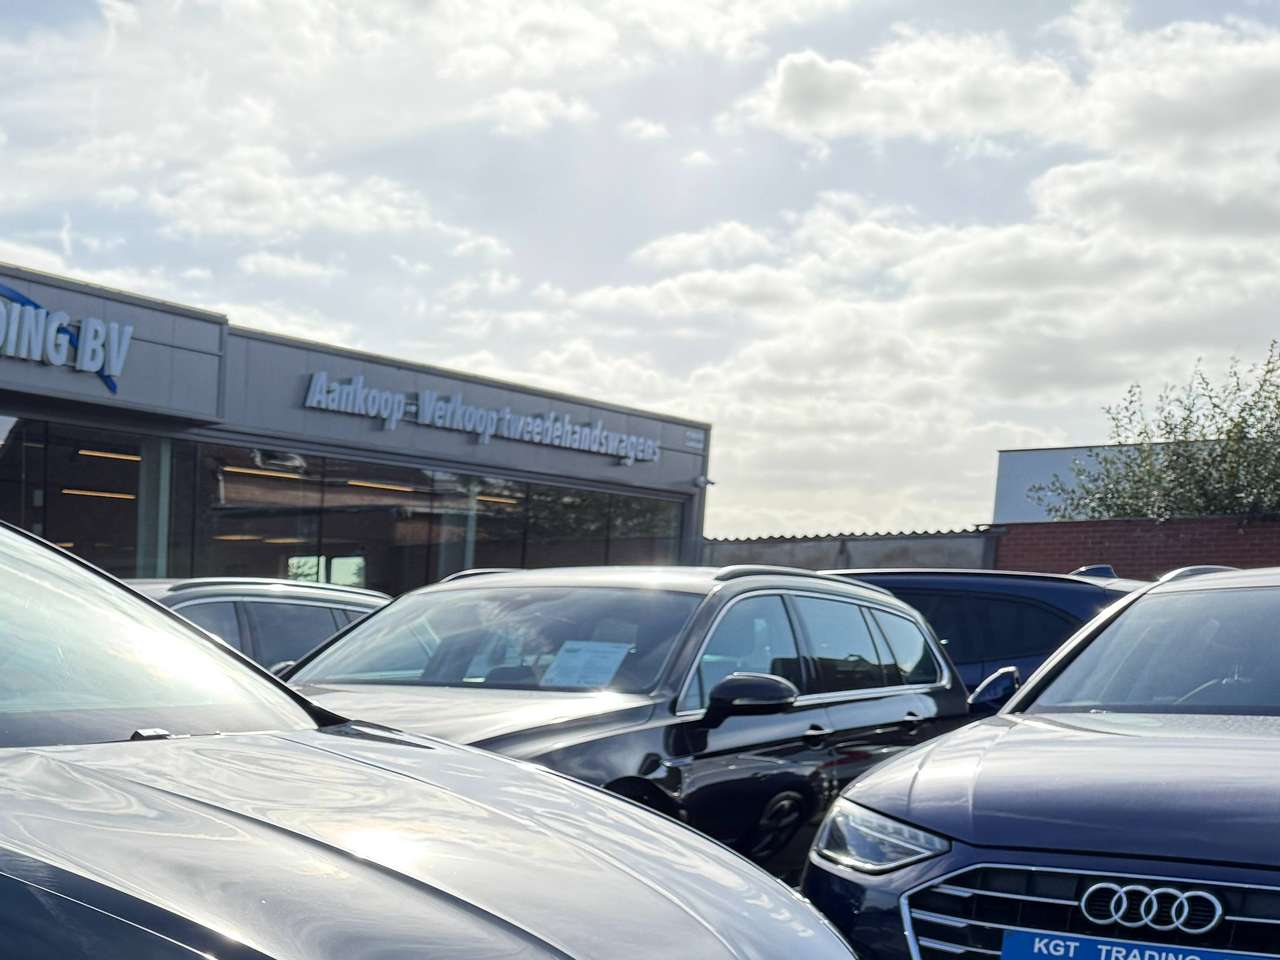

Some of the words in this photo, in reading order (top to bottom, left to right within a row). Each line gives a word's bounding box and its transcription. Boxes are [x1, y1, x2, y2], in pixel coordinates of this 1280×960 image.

[75, 316, 134, 377] BV
[304, 371, 406, 431] Aankoop
[418, 389, 498, 445] Verkoop
[1033, 937, 1080, 958] KGT
